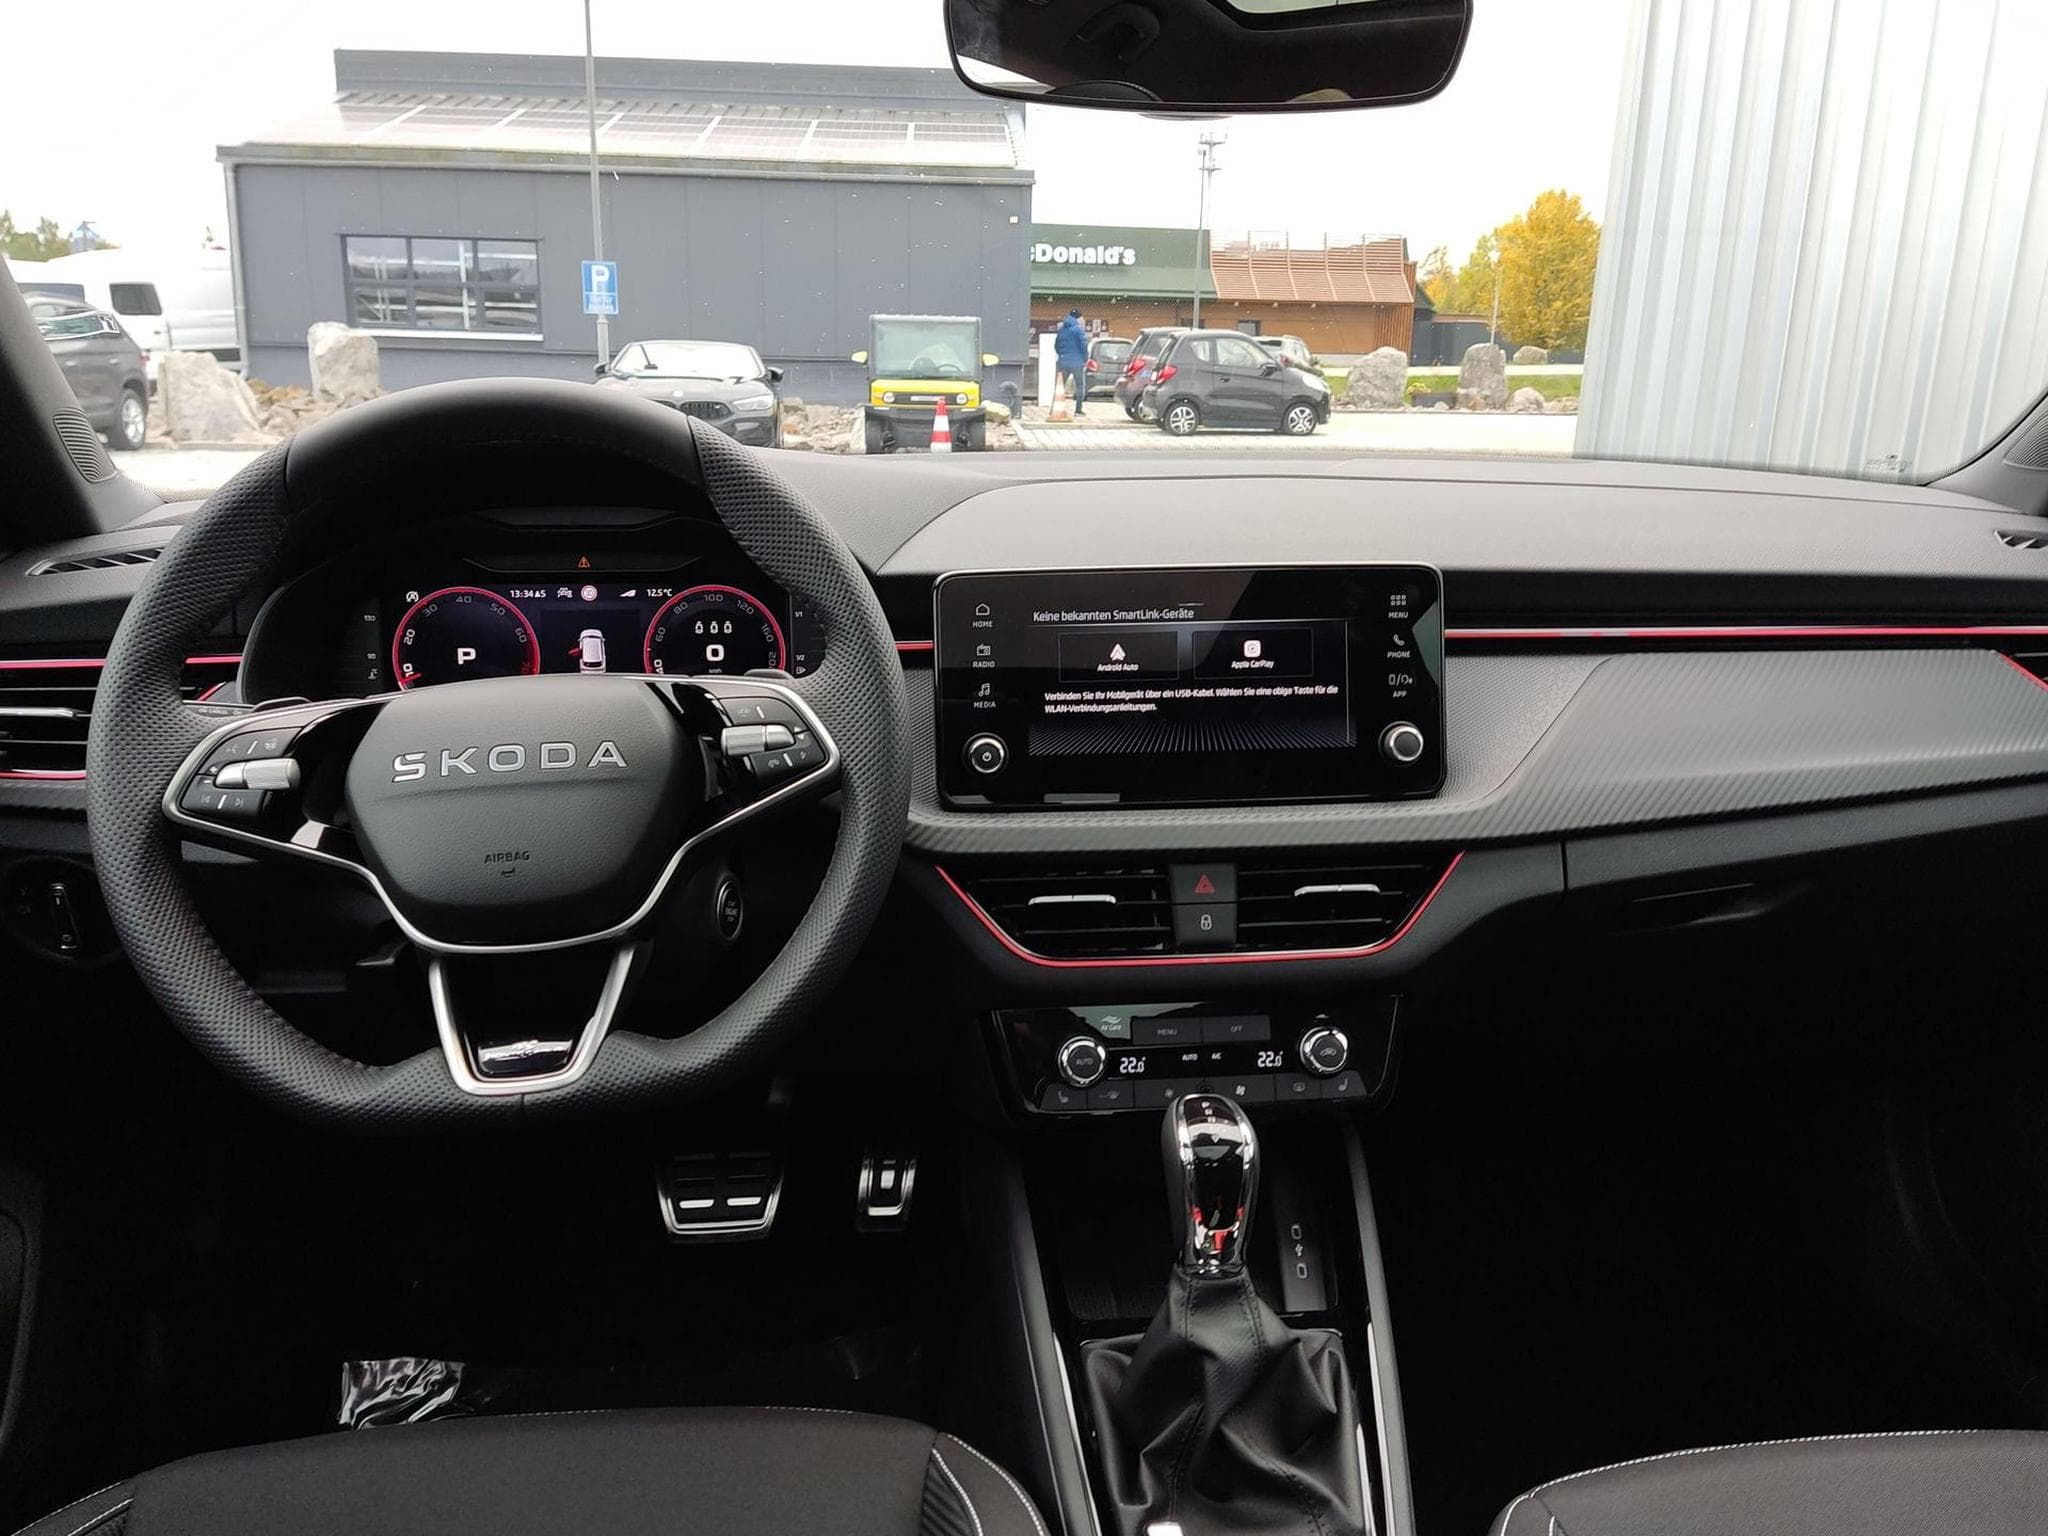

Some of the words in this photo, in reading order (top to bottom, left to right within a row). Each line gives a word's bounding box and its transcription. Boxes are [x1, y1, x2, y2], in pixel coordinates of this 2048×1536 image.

[591, 264, 610, 293] P
[455, 595, 472, 604] 40
[510, 589, 533, 599] 13:34
[704, 593, 724, 602] 100
[422, 603, 438, 617] 30
[489, 602, 506, 616] 50
[673, 601, 689, 615] 80
[737, 600, 755, 615] 120
[1033, 611, 1060, 622] Keine
[1061, 610, 1112, 621] bekannten
[1113, 608, 1195, 620] SmartLink-Geräte
[1388, 611, 1409, 619] MENU
[973, 620, 993, 628] HOME
[403, 628, 416, 646] 20
[514, 627, 528, 643] 60
[654, 626, 667, 642] 60
[761, 623, 775, 643] 160
[456, 647, 477, 665] P
[705, 643, 725, 662] 0
[402, 662, 415, 677] 10
[1097, 663, 1122, 672] Android
[1123, 663, 1139, 671] Auto
[1231, 661, 1249, 670] Apple
[1250, 660, 1275, 669] CarPlay
[1044, 691, 1082, 701] Verbinden
[1083, 691, 1094, 700] Sie
[1095, 691, 1105, 700] Ihr
[1106, 690, 1144, 701] Mobilgerät
[1145, 689, 1161, 699] über
[1162, 689, 1174, 698] ein
[1216, 687, 1243, 697] Wählen
[1243, 687, 1256, 697] Sie
[1256, 687, 1272, 696] eine
[1272, 687, 1293, 697] obige
[1293, 686, 1314, 696] Taste
[1315, 685, 1326, 695] für
[1326, 685, 1339, 695] die
[1393, 690, 1408, 698] APP
[1044, 703, 1158, 713] WLAN-Verbindungsanleitungen.
[484, 850, 531, 864] AIRBAG
[1156, 1028, 1178, 1036] MENU
[1230, 1025, 1243, 1033] OFF
[1075, 1058, 1093, 1066] AUTO
[1182, 1053, 1198, 1061] AUTO
